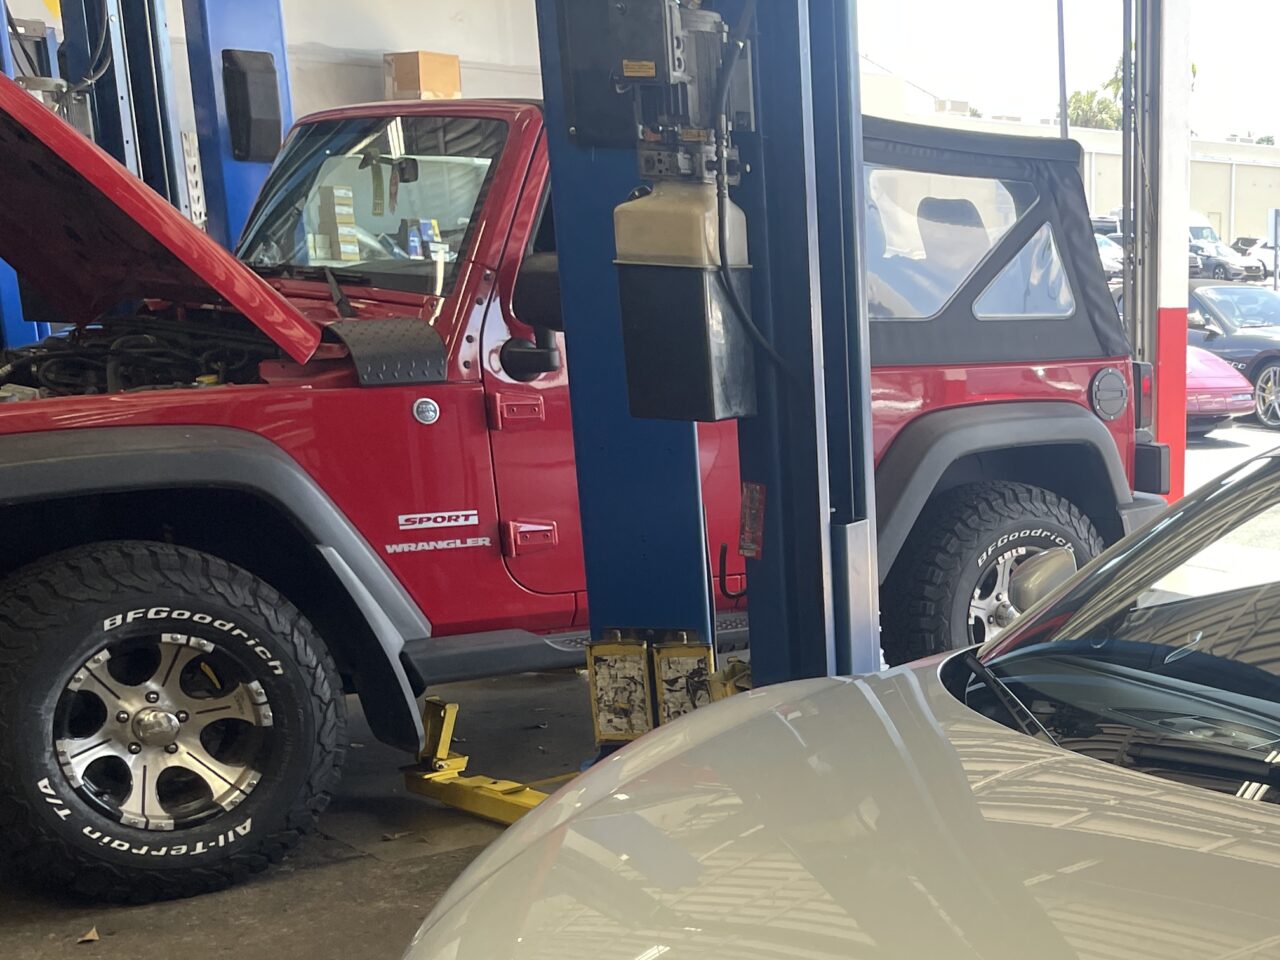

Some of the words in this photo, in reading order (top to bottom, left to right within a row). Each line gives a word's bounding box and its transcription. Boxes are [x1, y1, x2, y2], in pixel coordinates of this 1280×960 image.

[400, 514, 477, 526] SPORT
[385, 537, 491, 554] WRANGLER
[978, 528, 1074, 567] BFGoodrich
[103, 607, 284, 675] BFGoodrich
[37, 777, 72, 821] T/A
[82, 817, 252, 856] All-Terrain
